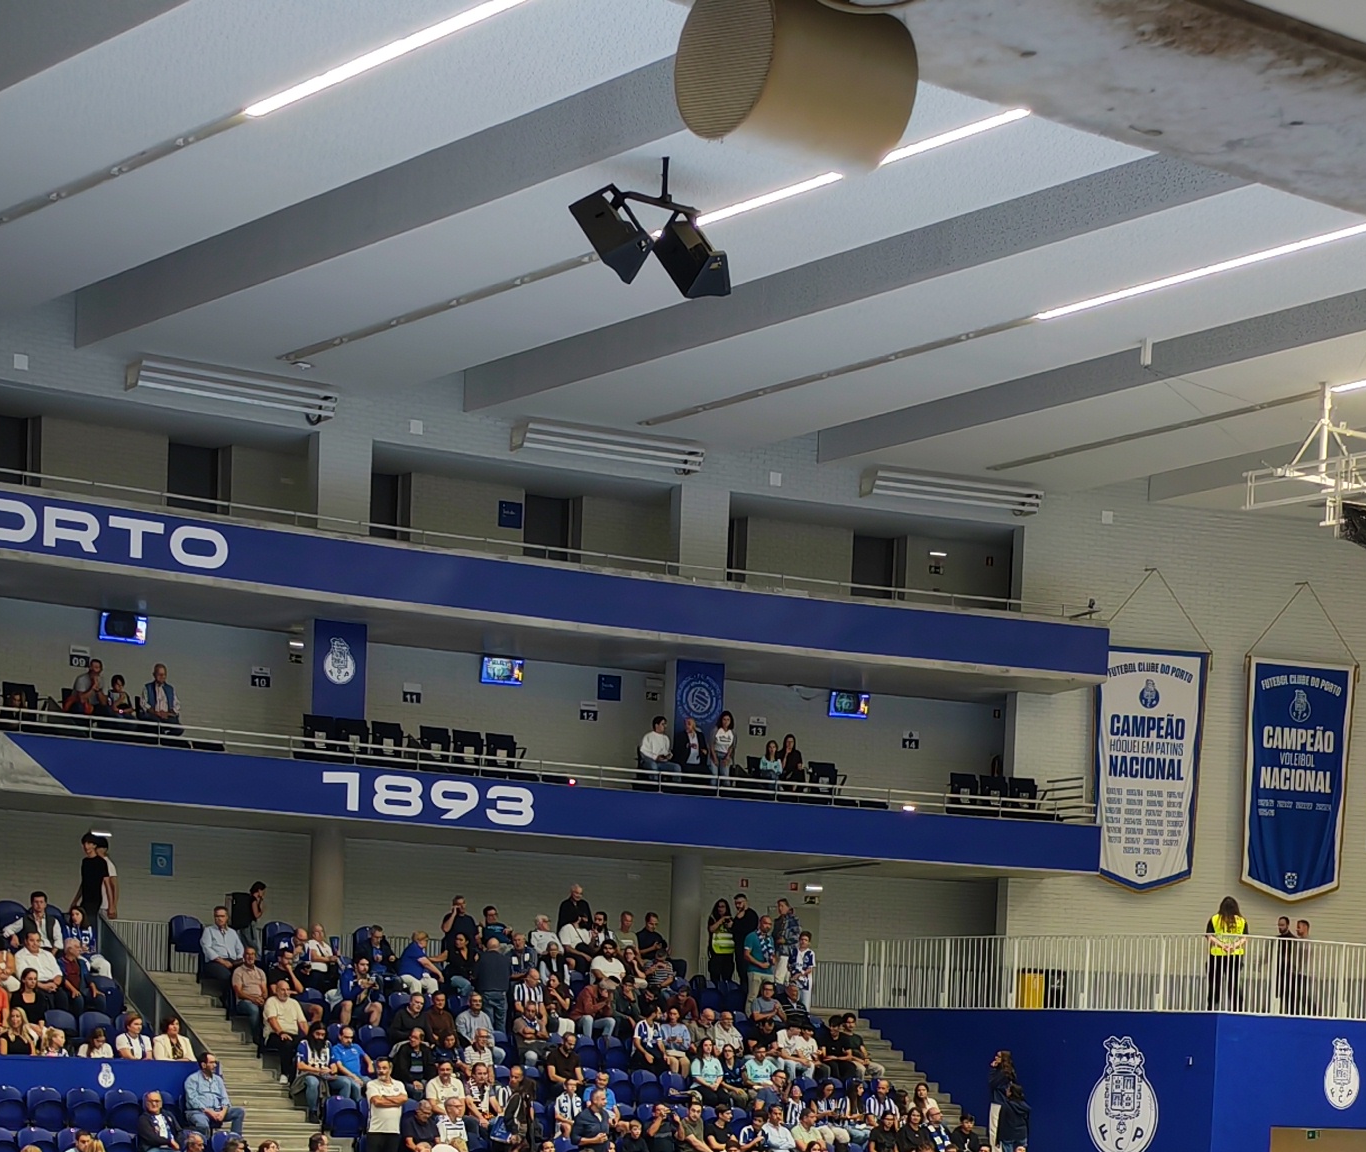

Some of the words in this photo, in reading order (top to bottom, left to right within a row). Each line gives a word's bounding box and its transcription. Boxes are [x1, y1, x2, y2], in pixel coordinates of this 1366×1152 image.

[72, 656, 86, 666] 09
[254, 677, 267, 687] 10
[1138, 662, 1159, 673] CLUBE
[1160, 663, 1170, 675] DO
[1171, 667, 1193, 684] PORTO
[1320, 679, 1341, 697] PORTO
[404, 693, 419, 704] 11
[583, 711, 596, 721] 12
[751, 726, 766, 736] 13
[1110, 713, 1185, 740] CAMPEÃO
[905, 740, 919, 749] 14
[1110, 738, 1140, 754] HÓQUEI
[1141, 741, 1154, 755] EM
[1156, 742, 1184, 756] PATINS
[1263, 726, 1334, 753] CAMPEÃO
[1109, 755, 1184, 781] NACIONAL
[1280, 752, 1315, 767] VOLEIBOL
[1260, 766, 1331, 793] NACIONAL
[322, 771, 535, 827] 1893
